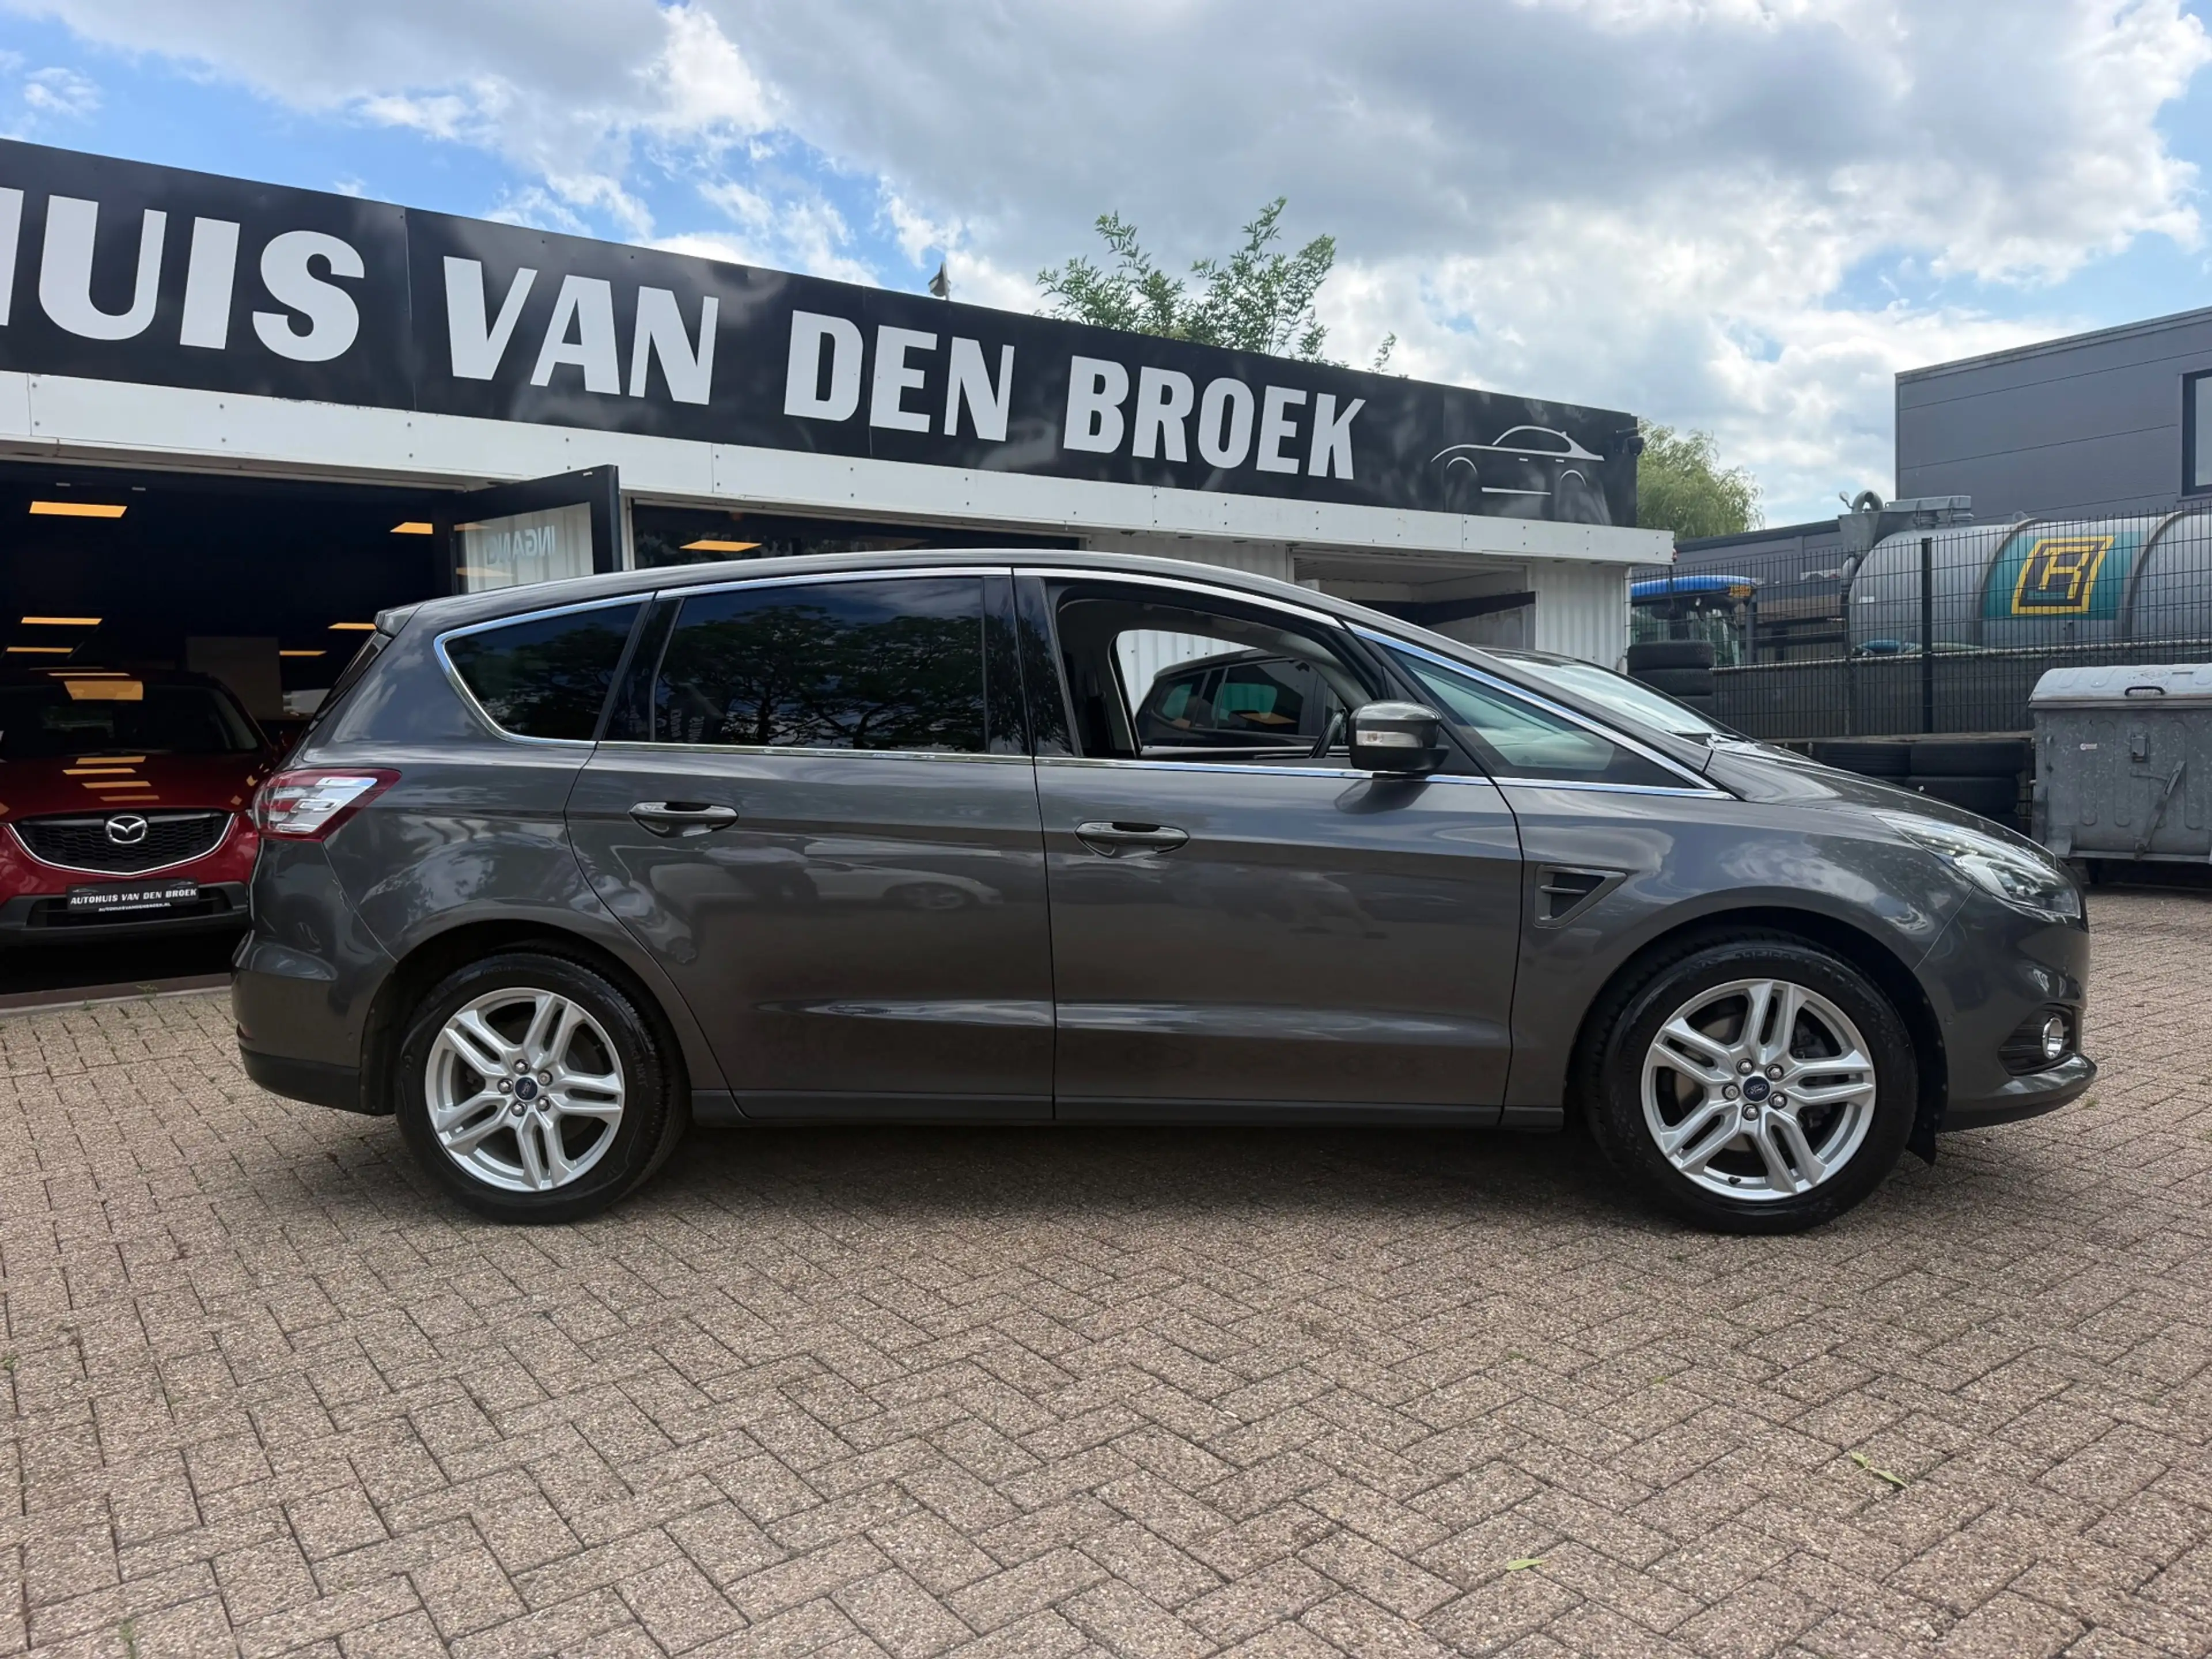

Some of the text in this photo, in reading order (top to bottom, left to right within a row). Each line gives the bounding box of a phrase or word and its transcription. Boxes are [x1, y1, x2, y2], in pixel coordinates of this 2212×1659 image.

[0, 187, 1366, 480] UIS VAN DEN BROEK
[70, 888, 197, 904] AUTOHUIS VAN DEN BROEK
